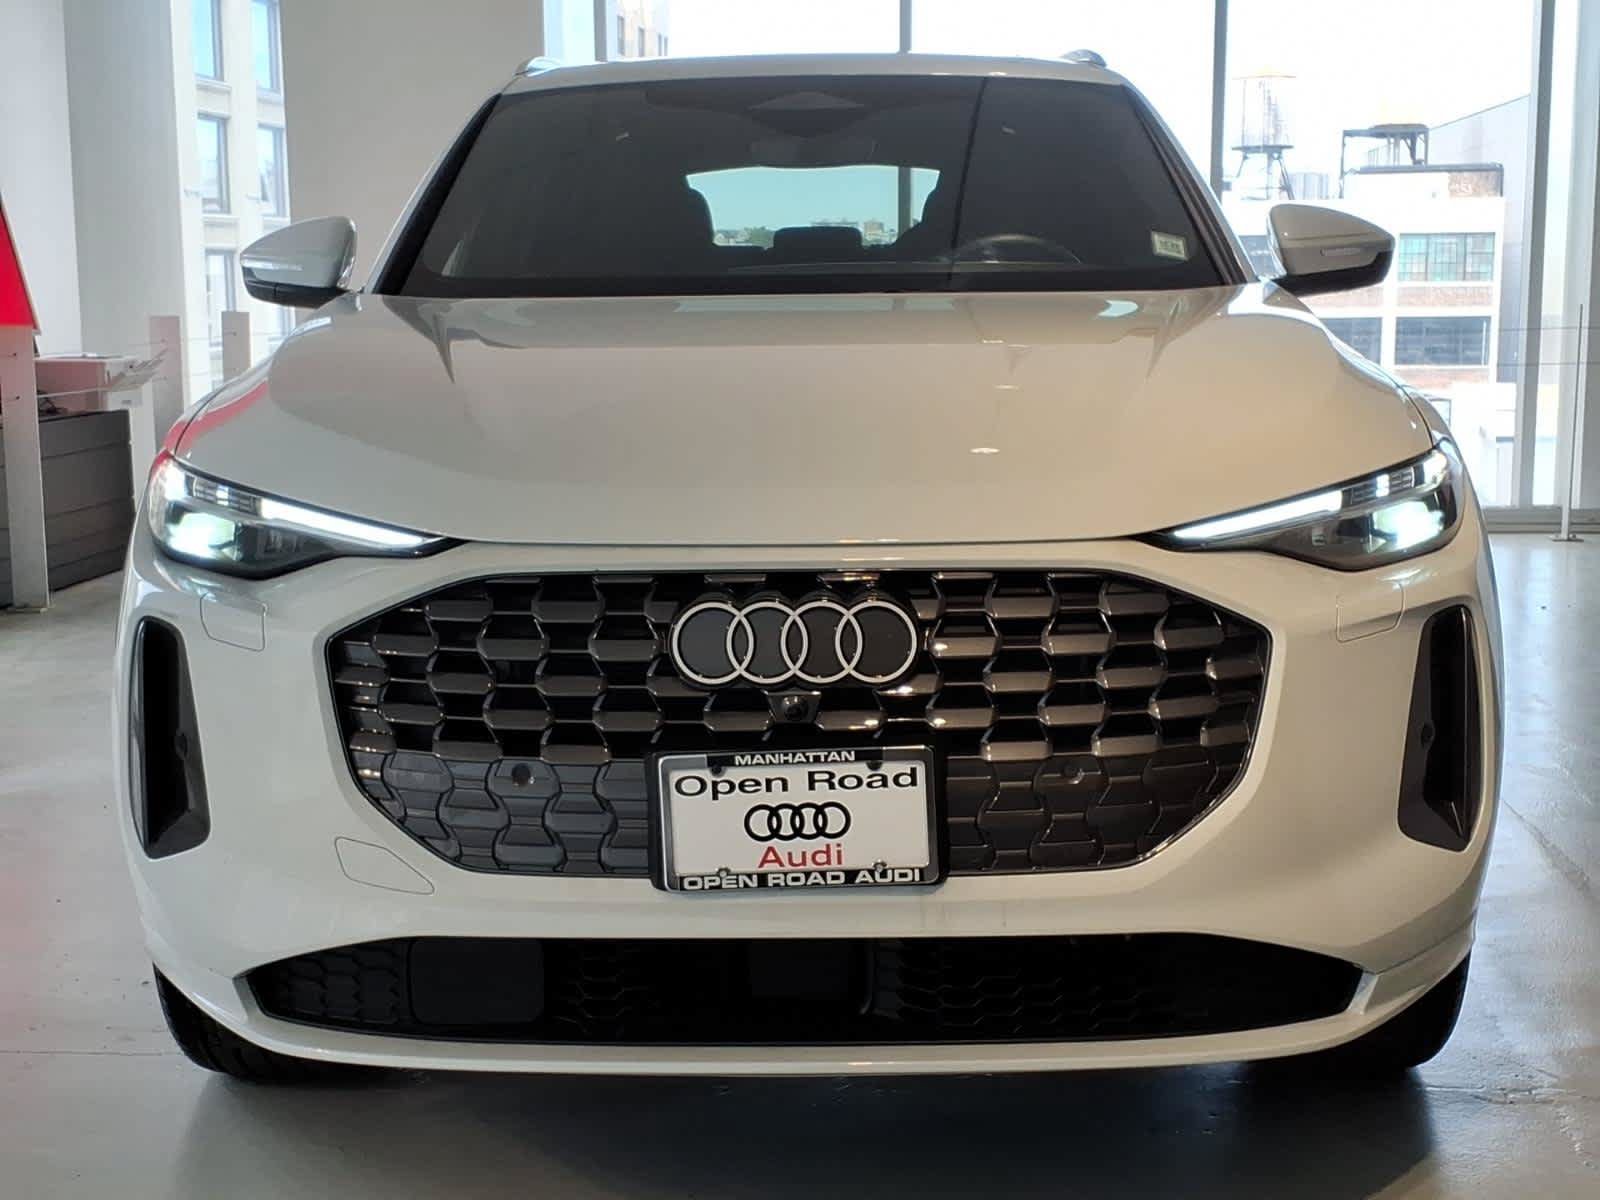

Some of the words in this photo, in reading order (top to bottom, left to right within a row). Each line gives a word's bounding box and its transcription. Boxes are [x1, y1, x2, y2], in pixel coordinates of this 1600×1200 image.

[734, 750, 856, 766] MANHATTAN
[674, 775, 789, 801] Open
[807, 767, 918, 792] Road
[757, 843, 843, 868] Audi
[683, 873, 758, 890] OPEN
[767, 870, 846, 887] ROAD
[855, 867, 920, 884] AUDI
